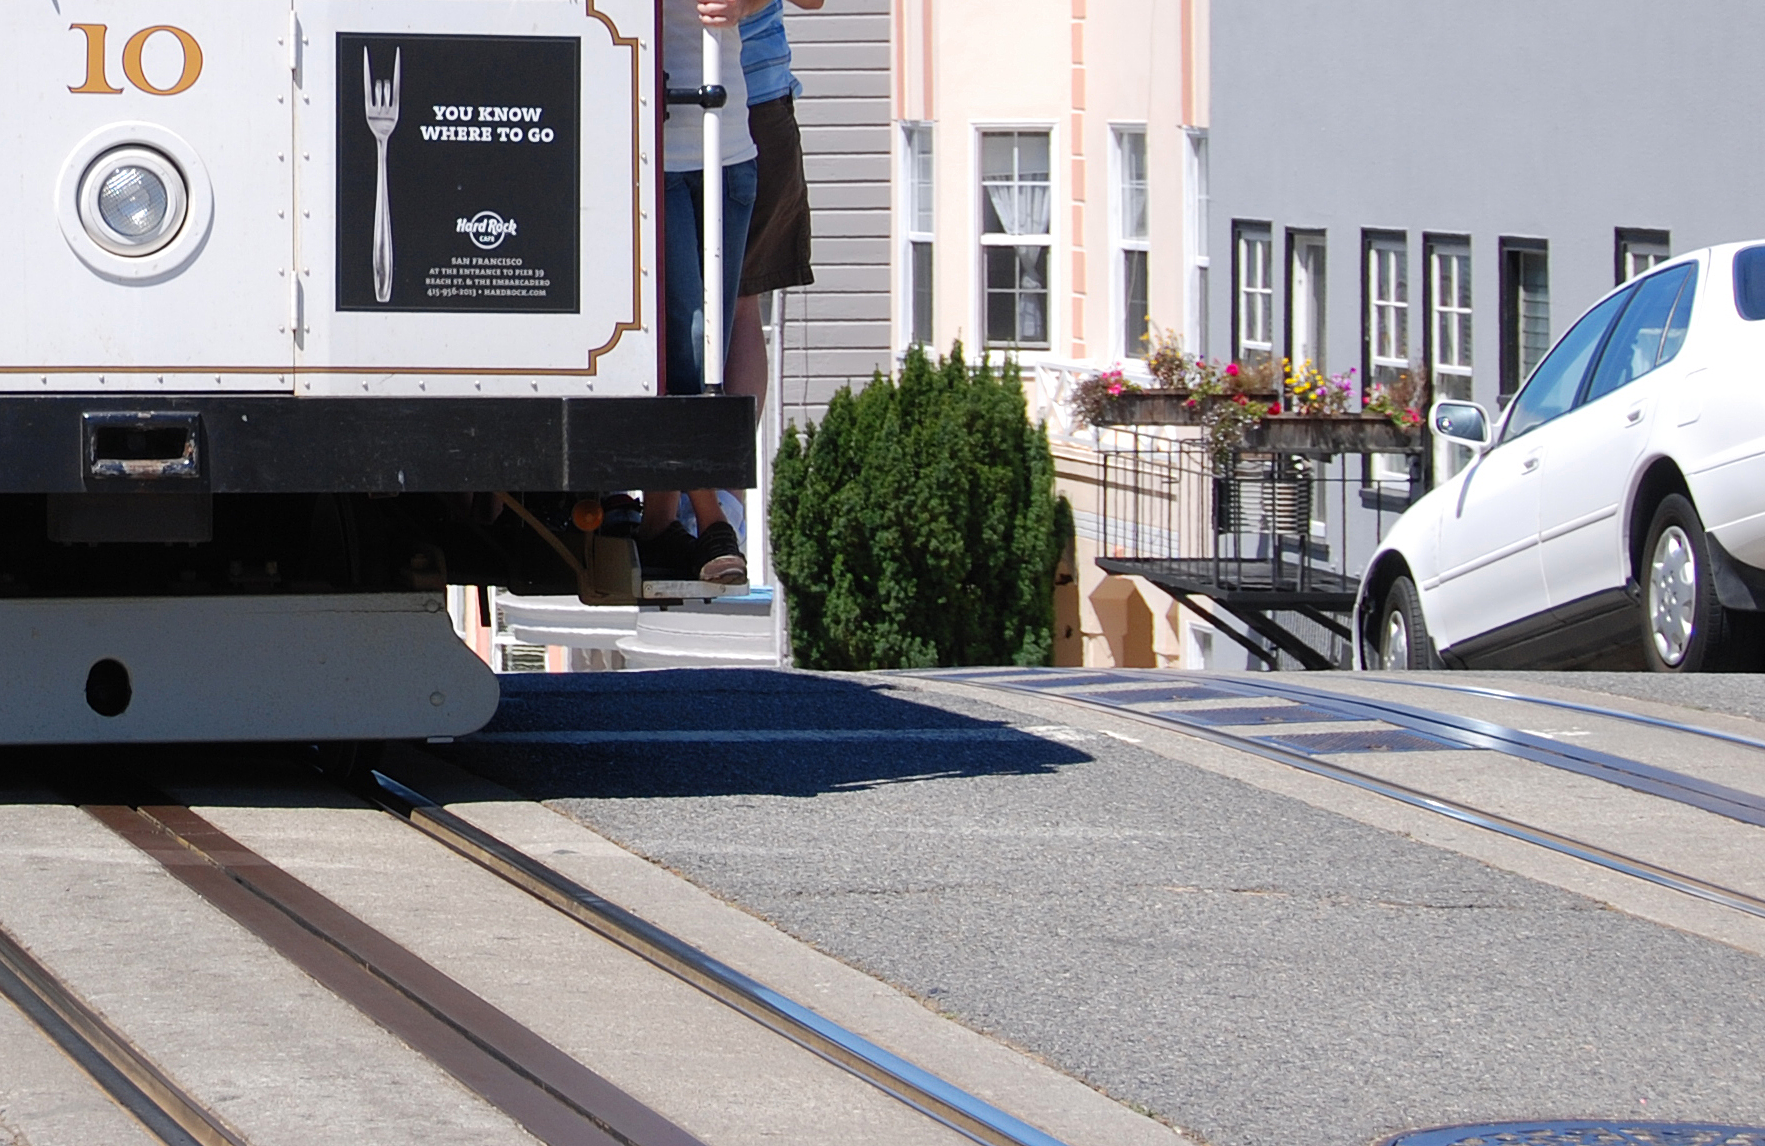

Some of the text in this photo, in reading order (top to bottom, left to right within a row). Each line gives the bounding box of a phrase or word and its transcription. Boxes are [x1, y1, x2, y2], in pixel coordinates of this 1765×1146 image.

[67, 22, 204, 97] 10
[432, 105, 542, 123] YOU KNOW
[420, 125, 555, 143] WHERE TO GO
[456, 218, 517, 236] Hard Rock
[451, 257, 523, 266] SAN FRANCISCO
[459, 268, 501, 276] ENTRANCE
[502, 268, 514, 276] TO
